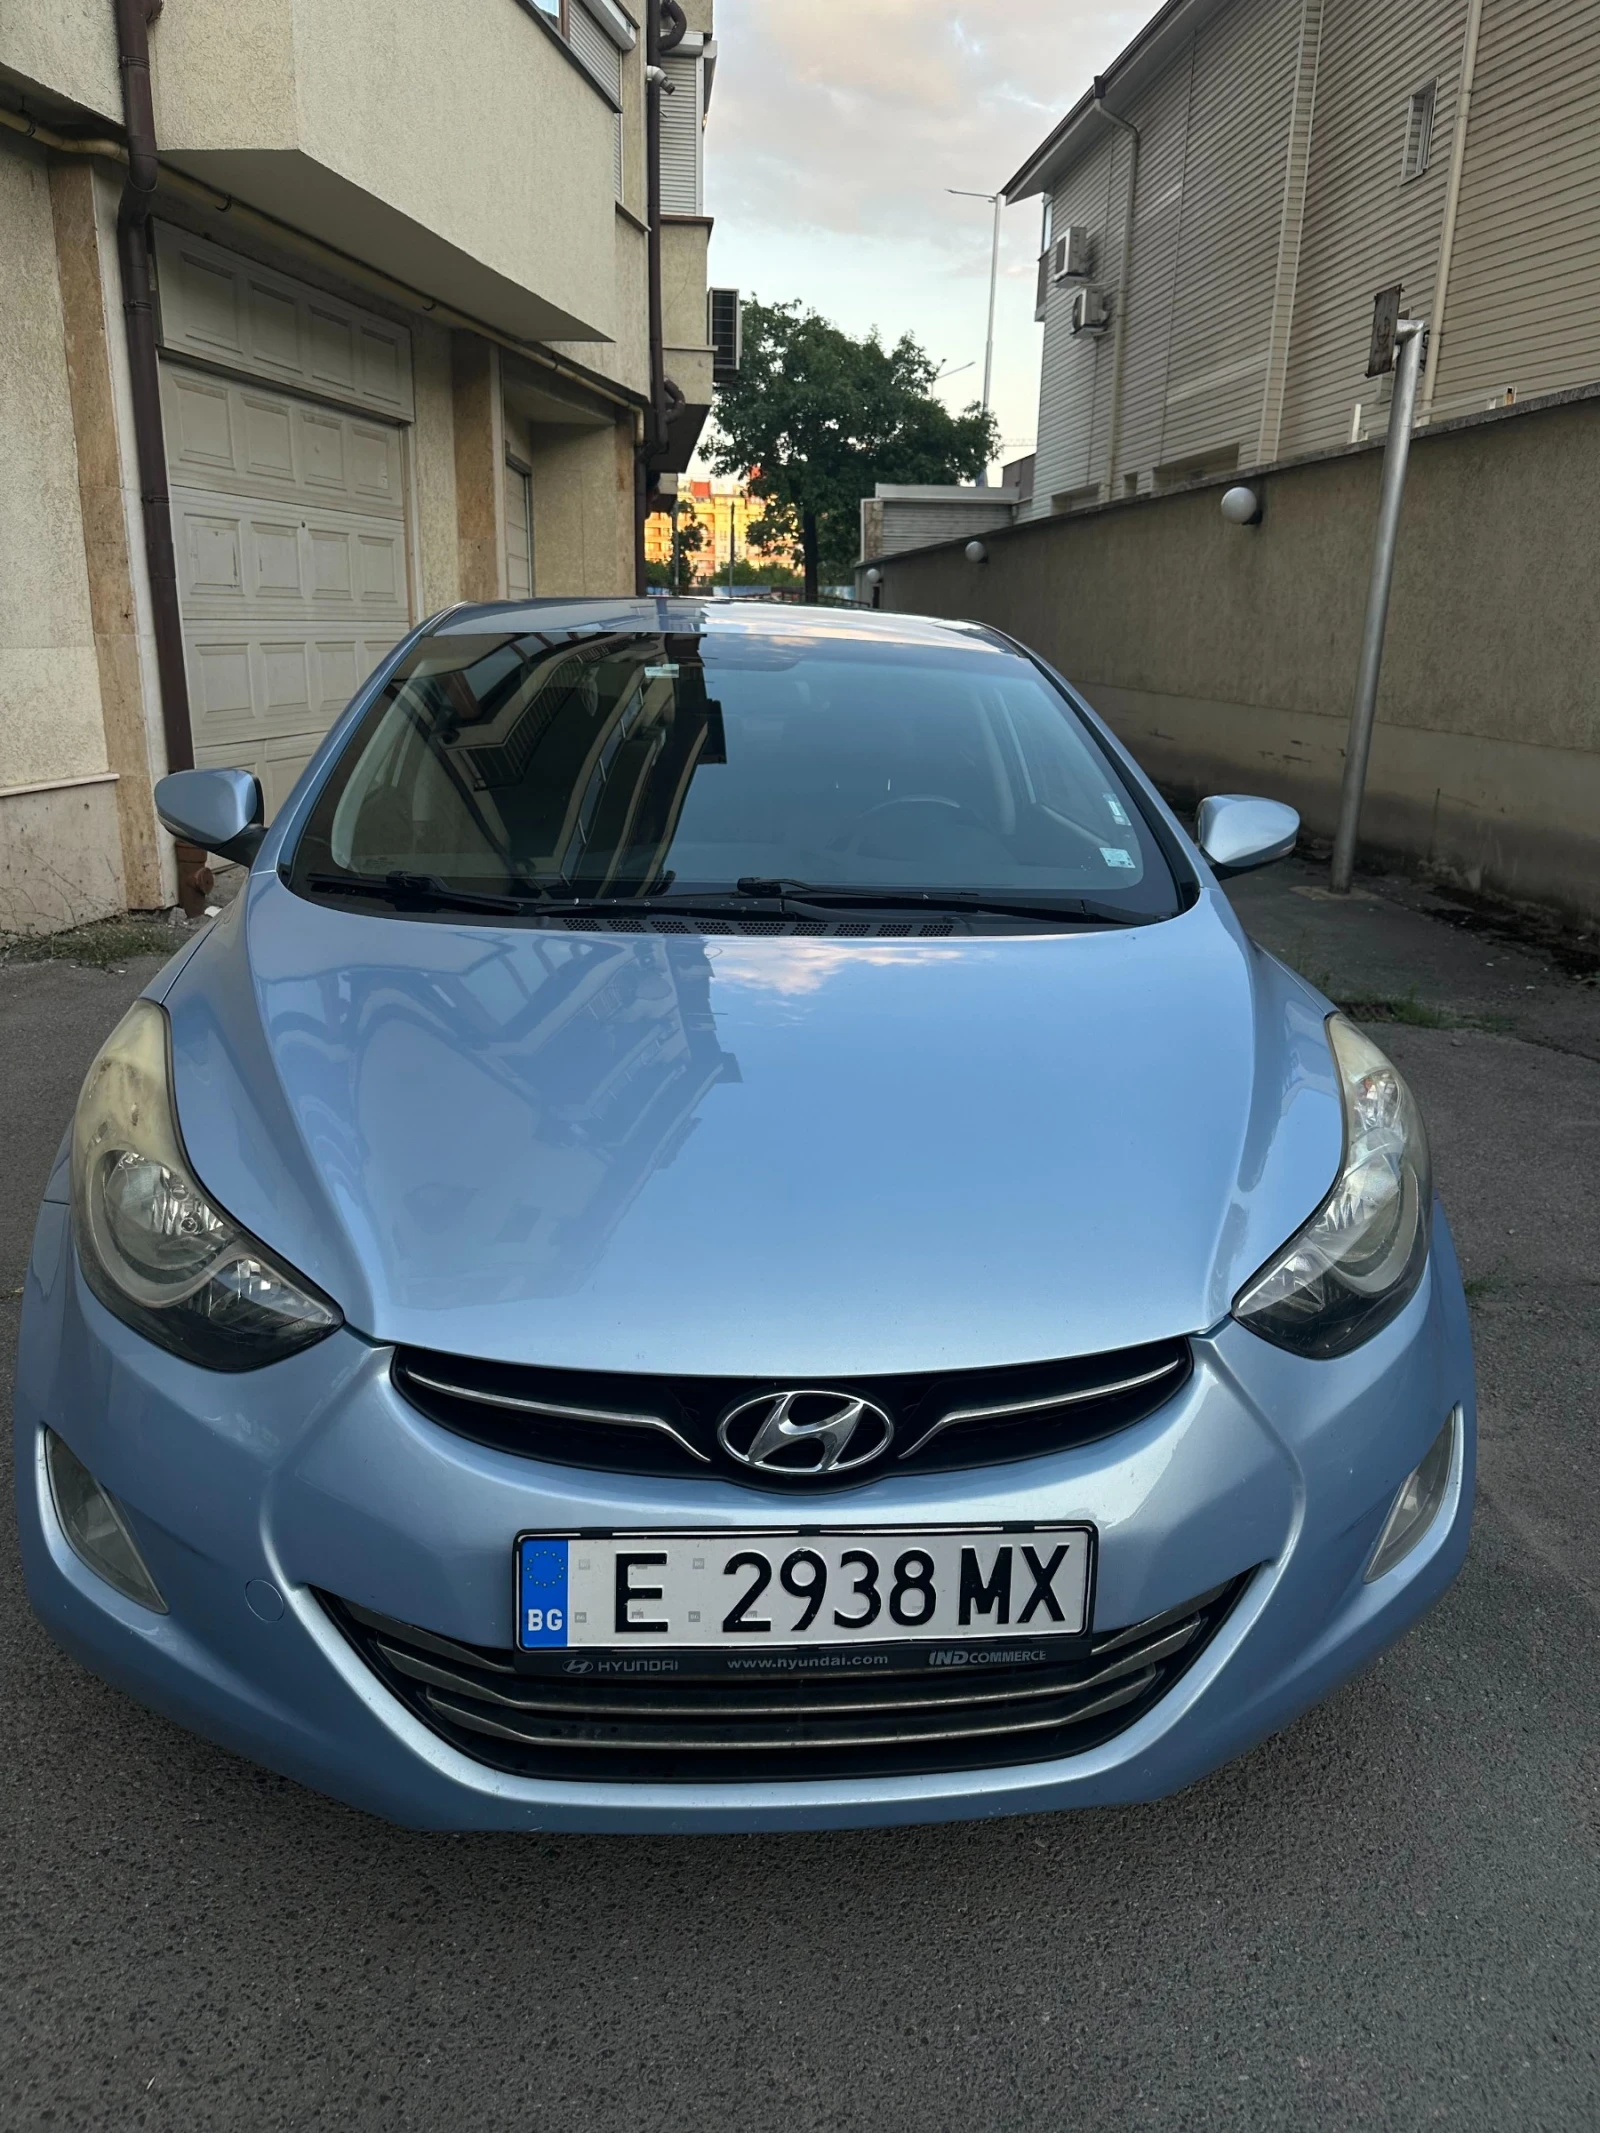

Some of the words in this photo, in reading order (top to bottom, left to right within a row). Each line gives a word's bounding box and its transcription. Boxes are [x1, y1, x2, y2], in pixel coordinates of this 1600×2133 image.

[615, 1551, 669, 1633] E
[722, 1547, 937, 1633] 2938
[958, 1543, 1071, 1626] MX
[527, 1608, 563, 1632] BG
[598, 1660, 679, 1672] HYUNDAI
[727, 1655, 888, 1670] www.hyundai.com
